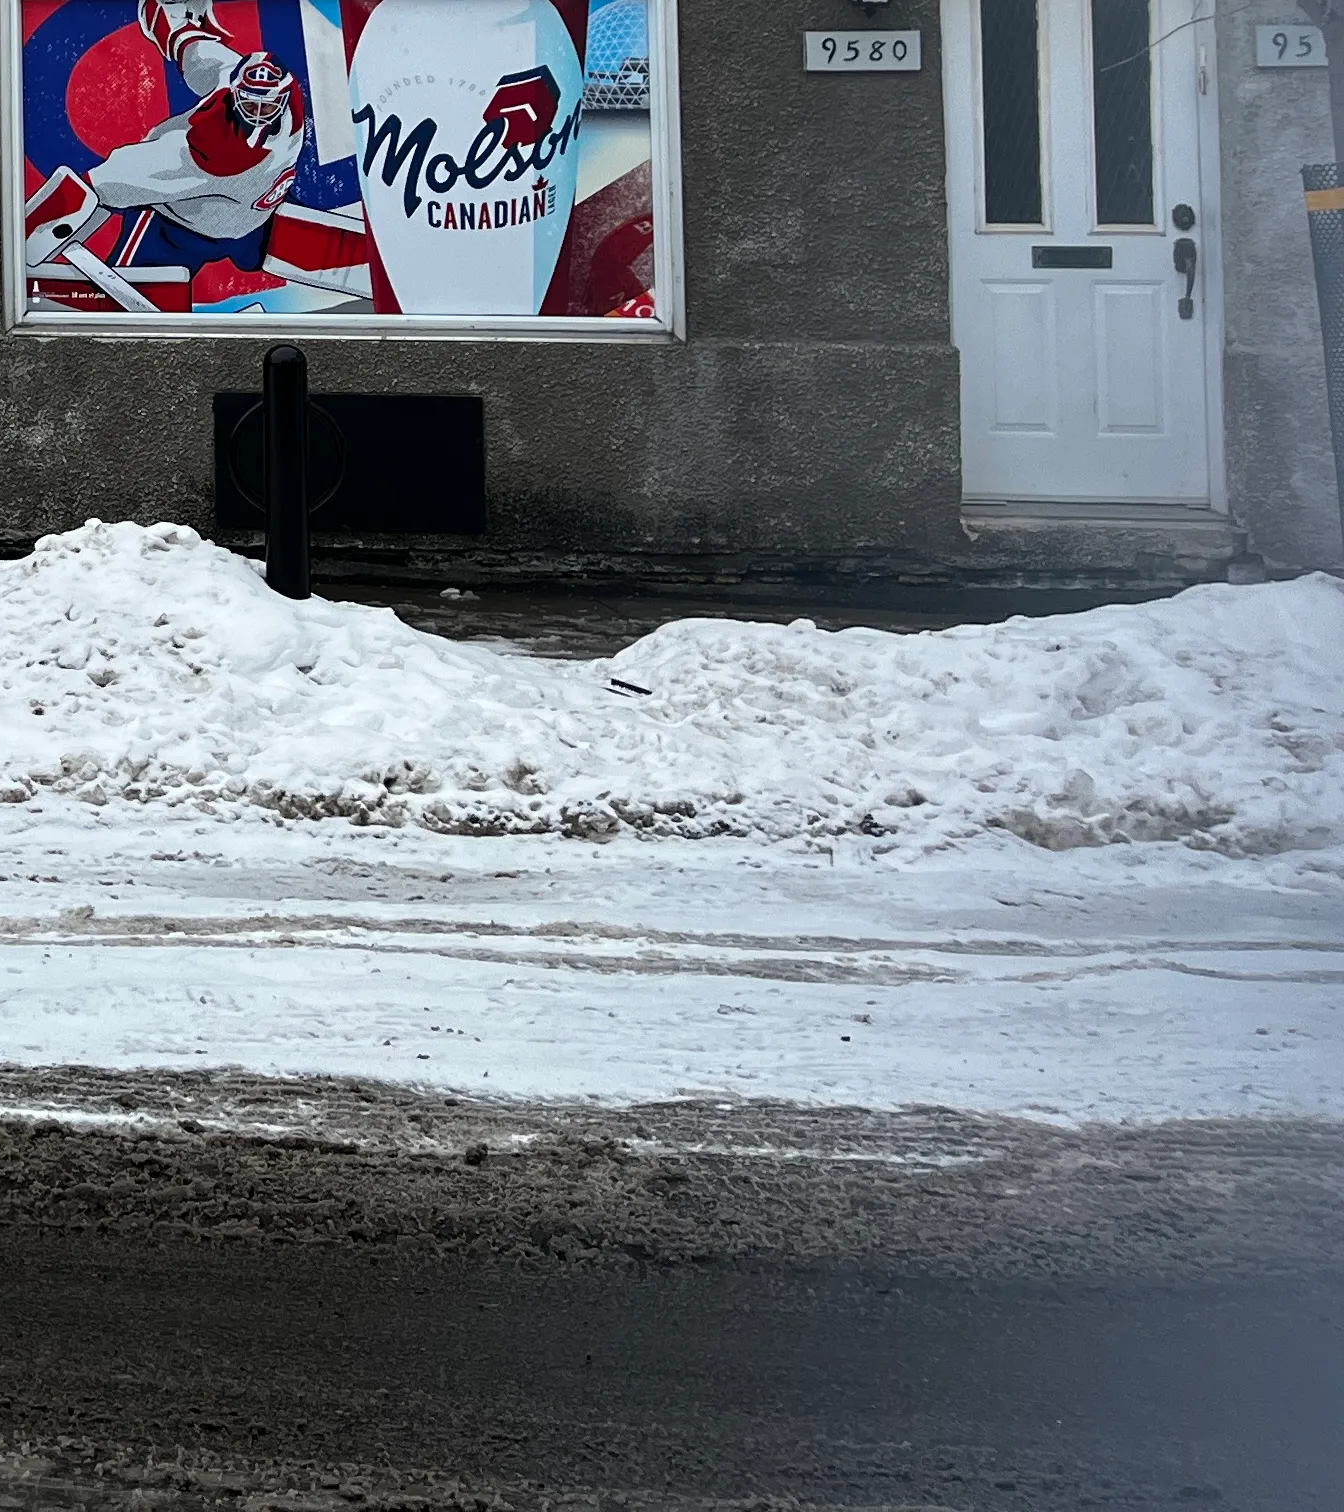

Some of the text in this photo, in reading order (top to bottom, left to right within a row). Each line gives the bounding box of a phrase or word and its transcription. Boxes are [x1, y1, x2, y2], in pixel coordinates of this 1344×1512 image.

[821, 36, 908, 63] 9580
[1272, 31, 1313, 58] 95
[376, 75, 435, 112] FOUNDED
[351, 98, 582, 219] Molson
[427, 189, 546, 230] CANADIAN
